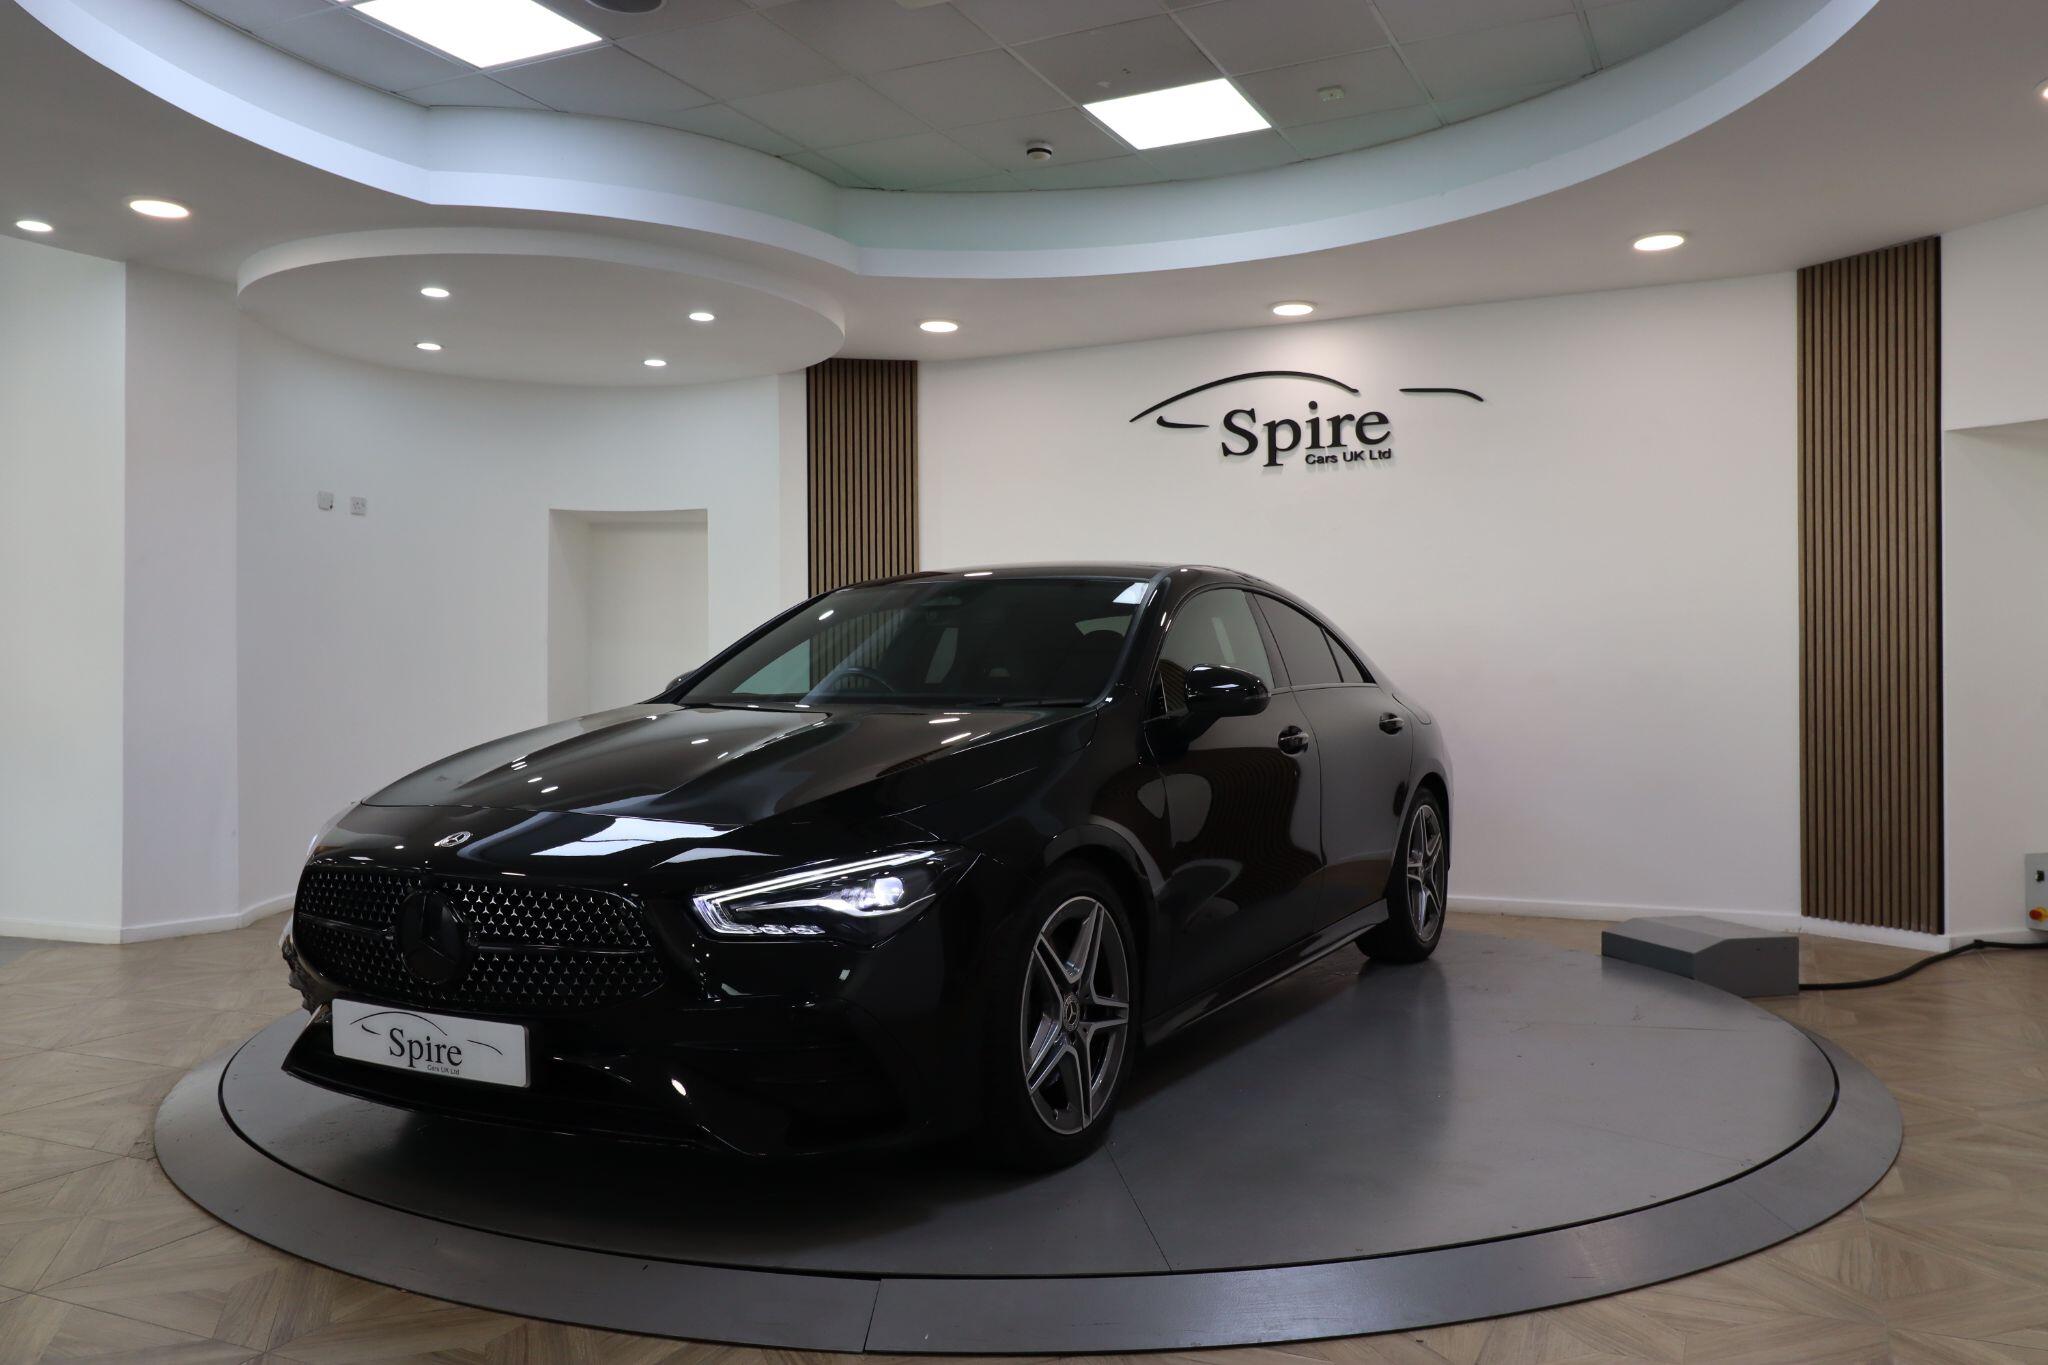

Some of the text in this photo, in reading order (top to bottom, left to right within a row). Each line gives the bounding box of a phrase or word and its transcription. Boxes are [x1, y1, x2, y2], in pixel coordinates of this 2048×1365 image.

[1221, 400, 1391, 467] Spire
[1305, 447, 1392, 465] Cars UK Ltd
[389, 1027, 462, 1068] Spire
[441, 1066, 450, 1074] UK
